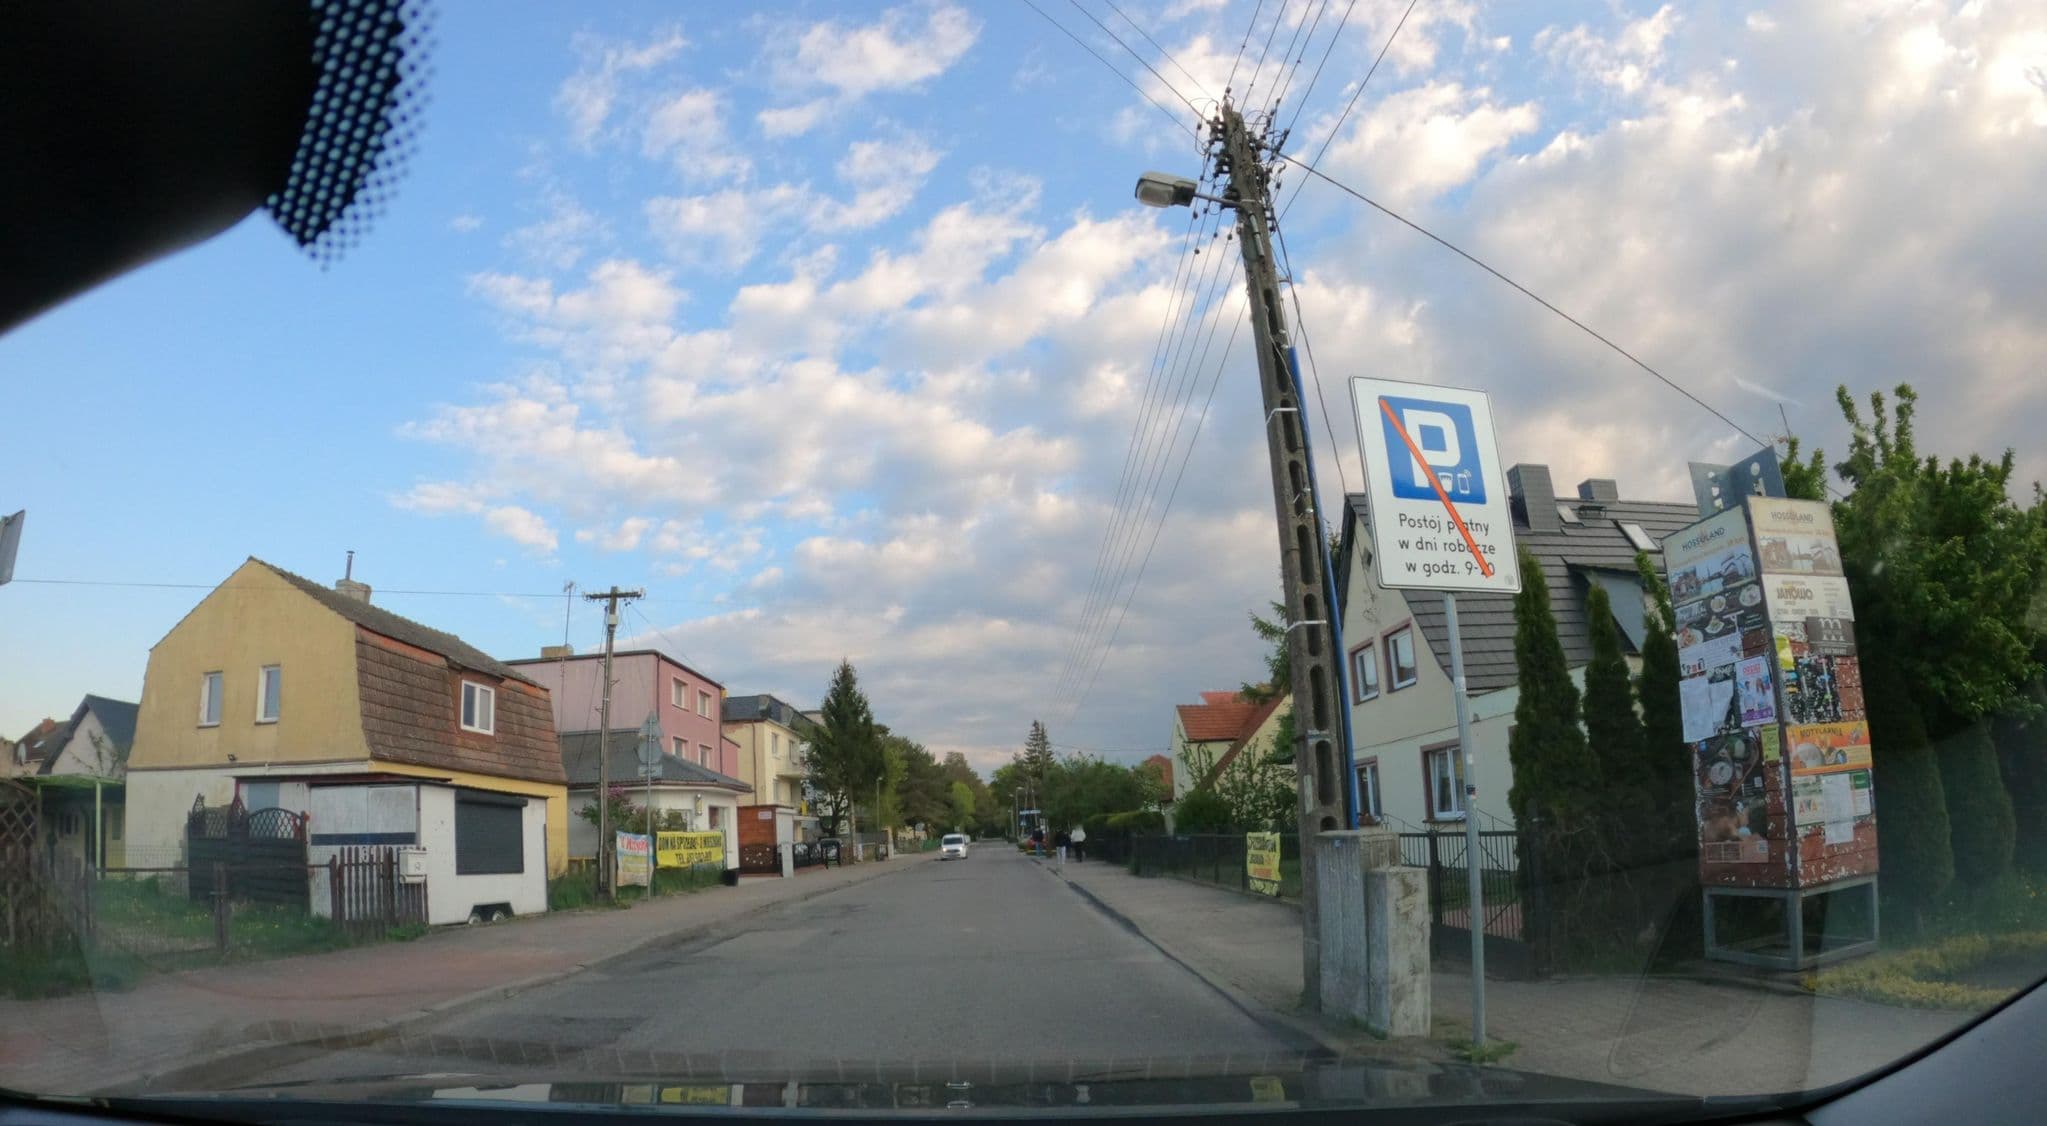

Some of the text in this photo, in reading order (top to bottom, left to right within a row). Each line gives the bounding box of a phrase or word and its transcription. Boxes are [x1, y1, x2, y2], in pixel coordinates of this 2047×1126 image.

[1403, 408, 1461, 488] P
[1398, 513, 1489, 536] Postój patny
[1398, 538, 1409, 549] w
[1415, 537, 1438, 551] dni
[1405, 561, 1416, 572] w
[1423, 560, 1460, 576] godz.
